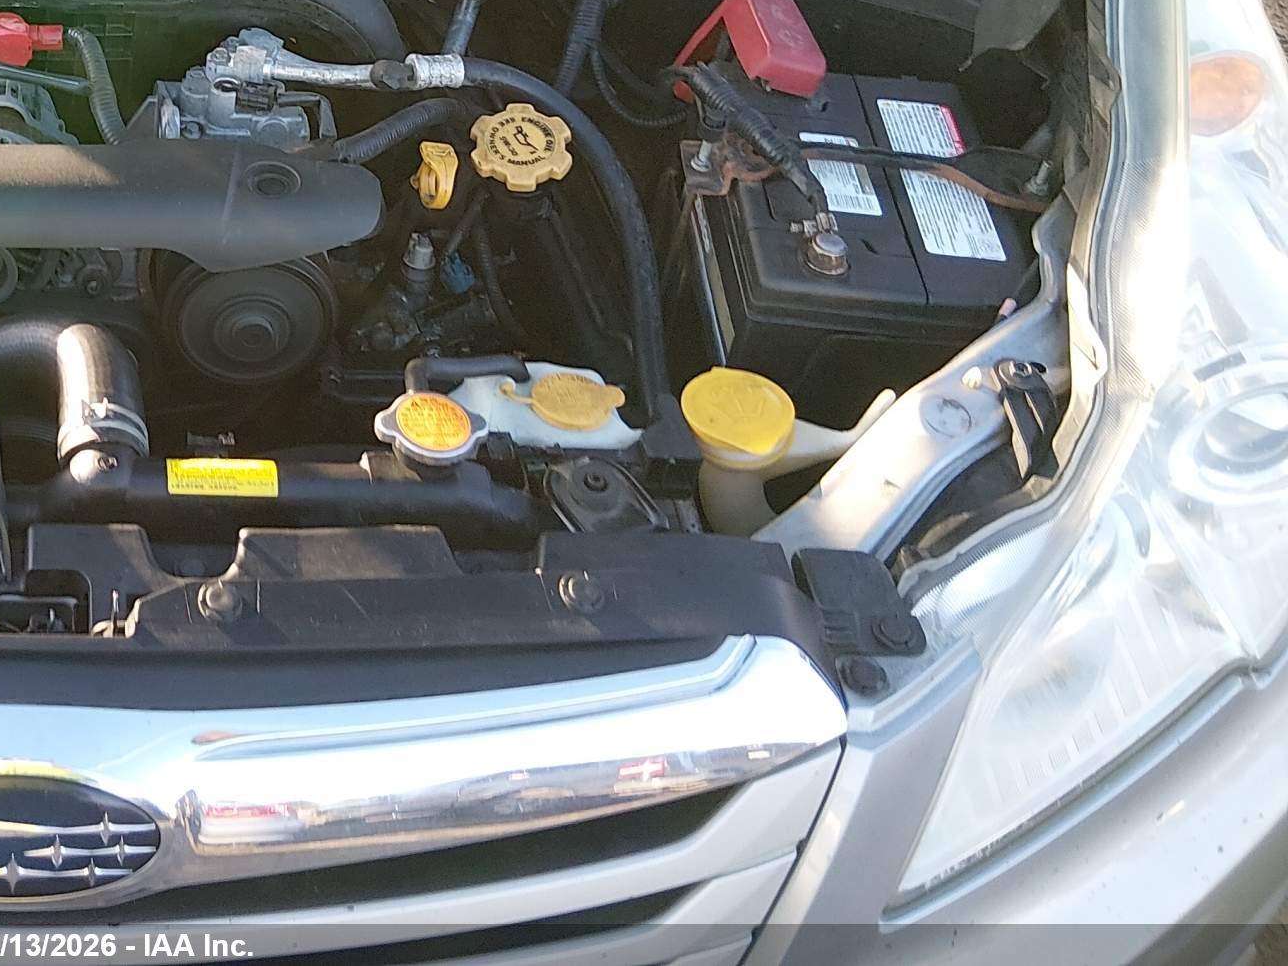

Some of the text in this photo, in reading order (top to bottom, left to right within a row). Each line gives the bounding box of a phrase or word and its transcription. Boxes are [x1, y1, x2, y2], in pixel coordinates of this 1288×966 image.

[498, 117, 516, 127] SEE
[507, 155, 546, 166] MANUAL
[521, 117, 554, 152] ENGINE OIL
